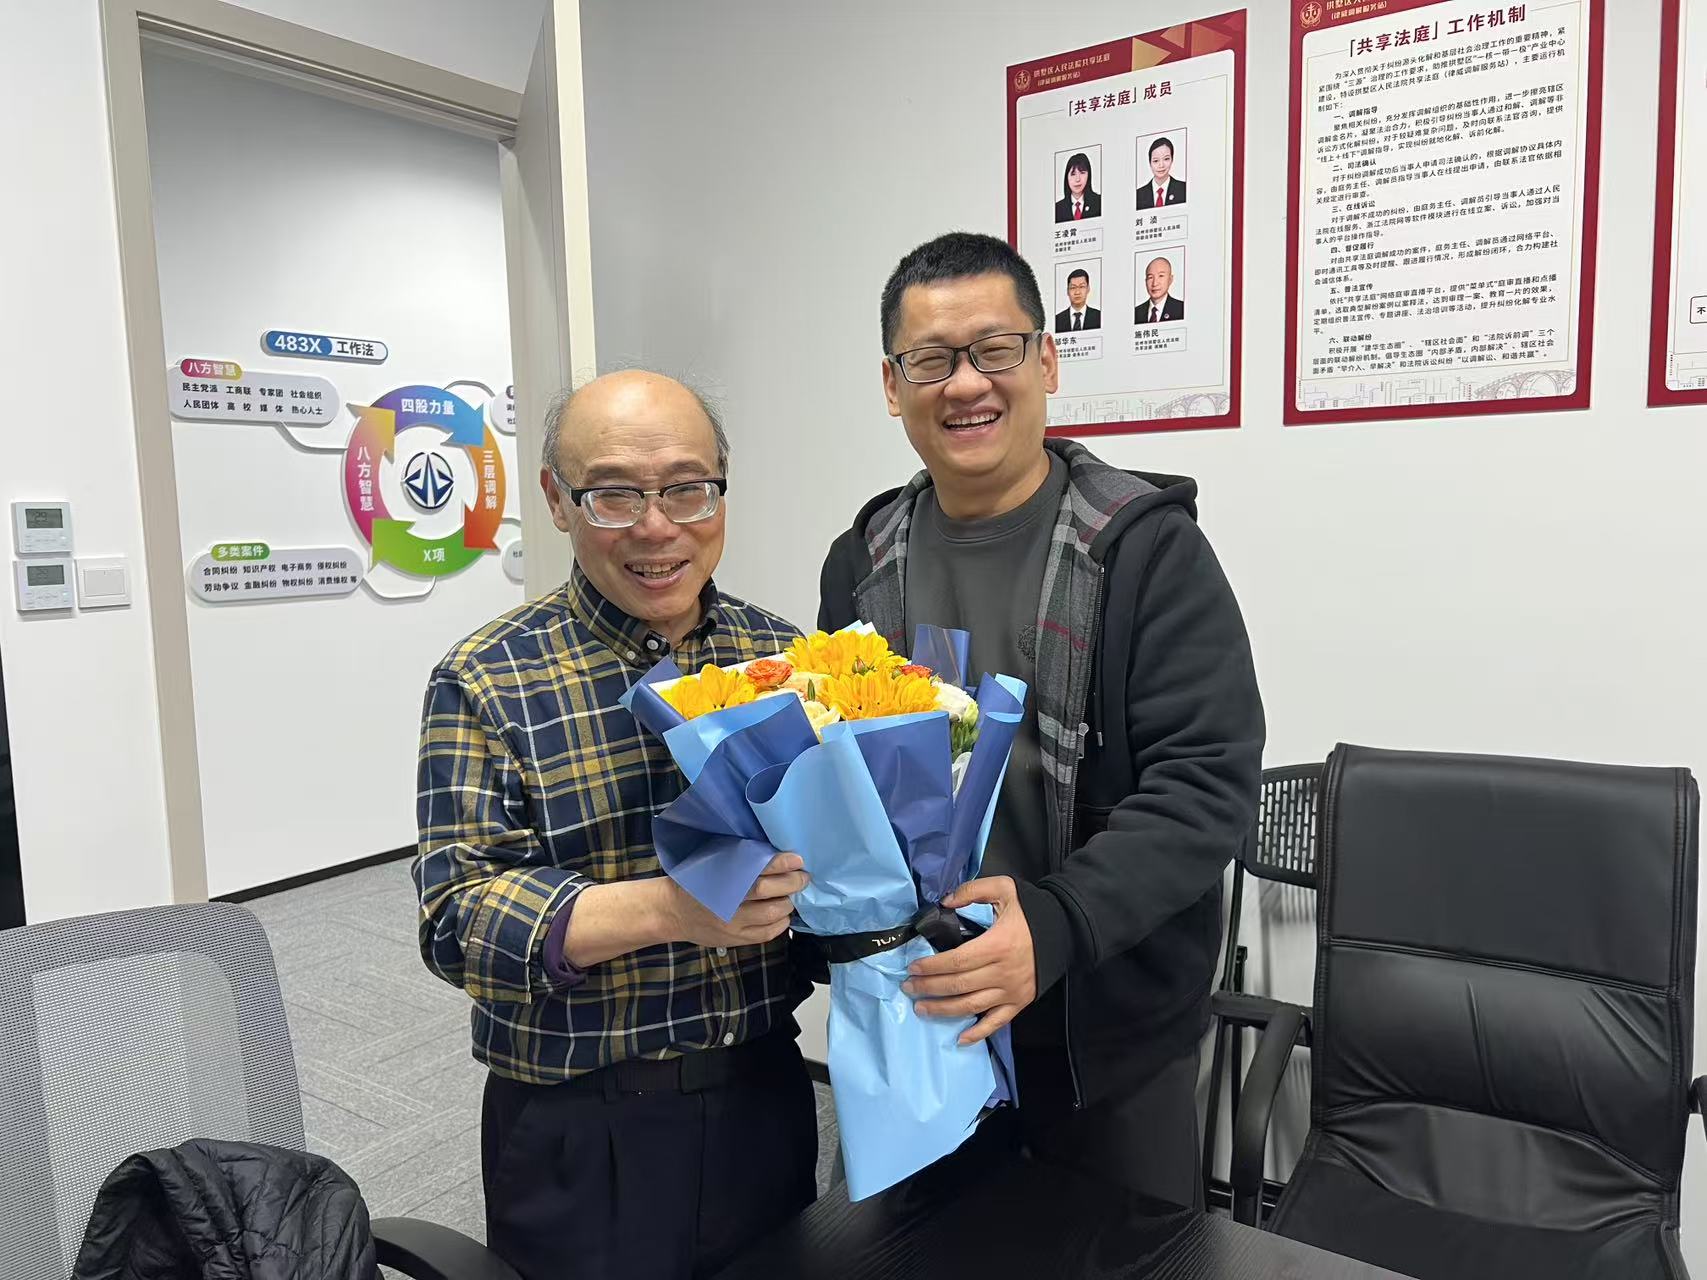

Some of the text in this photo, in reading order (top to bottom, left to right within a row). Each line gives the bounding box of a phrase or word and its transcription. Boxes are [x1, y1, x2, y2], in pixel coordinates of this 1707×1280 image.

[1349, 4, 1526, 57] 「共享法庭」工作机制
[1069, 81, 1173, 116] 「共享法庭」成员
[1333, 105, 1377, 121] 一、调解指导
[1332, 158, 1376, 172] 二、司法确认
[1331, 200, 1375, 213] 三、在线诉讼
[1329, 283, 1373, 294] 五、普法宣传
[1328, 333, 1371, 344] 六、联动解纷
[274, 334, 375, 358] 483X 工作法
[188, 362, 237, 376] 八方智慧
[226, 386, 251, 394] 工商联
[259, 388, 283, 397] 专家团
[183, 400, 219, 410] 人民团体
[401, 398, 455, 415] 四股力量
[357, 447, 374, 511] 八方智慧
[483, 450, 497, 509] 三层调解
[218, 546, 264, 558] 多类案件
[424, 549, 445, 562] X项
[203, 566, 238, 576] 合同纠纷
[243, 565, 276, 573] 知识产权
[204, 582, 239, 592] 劳动争议
